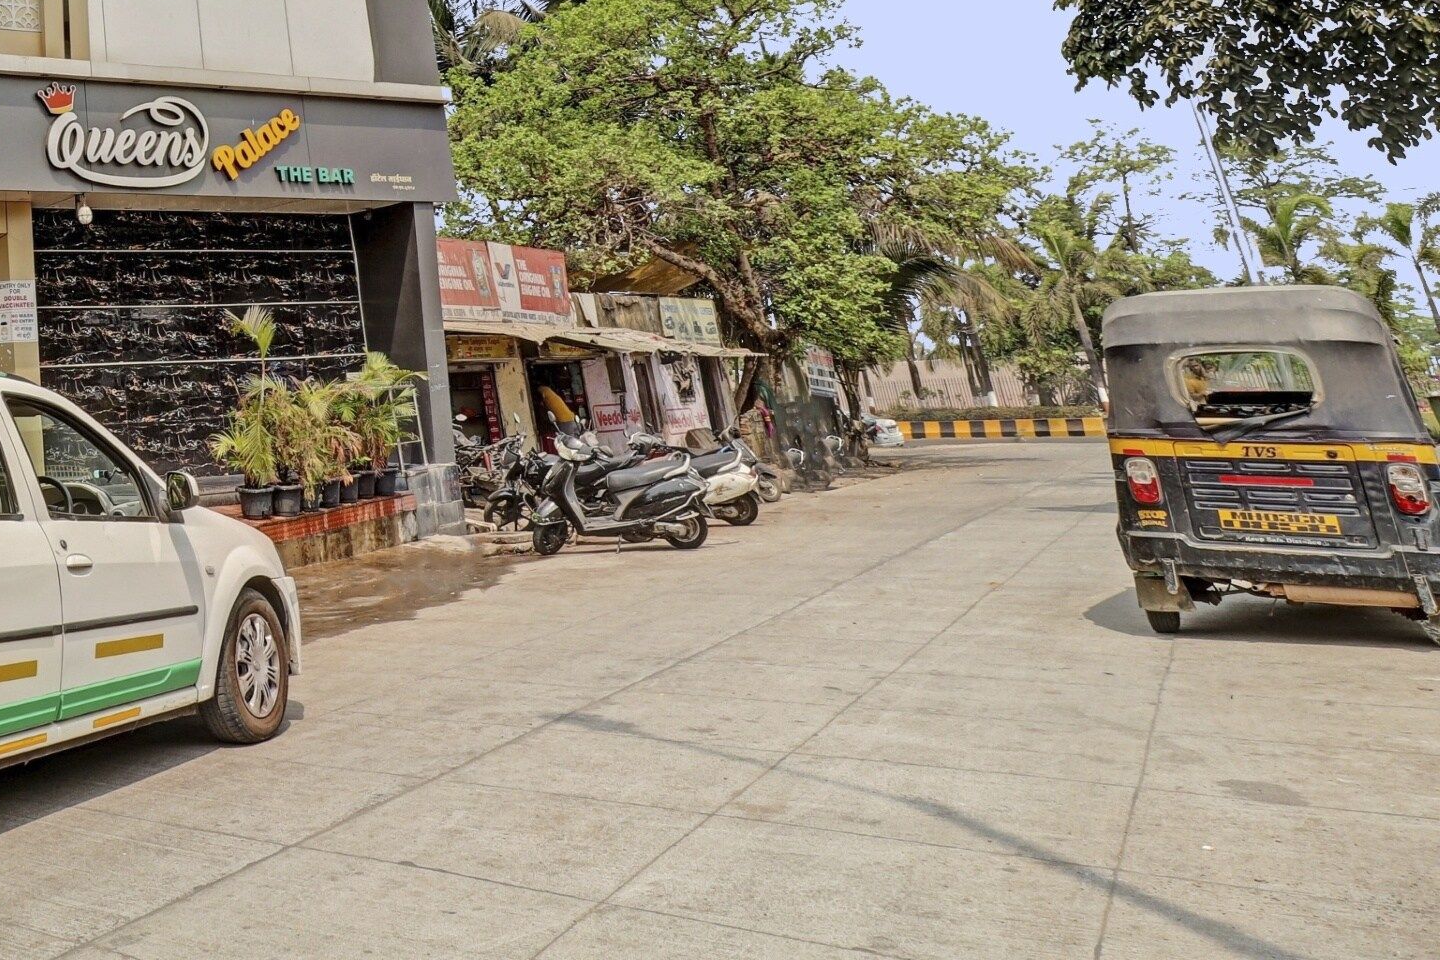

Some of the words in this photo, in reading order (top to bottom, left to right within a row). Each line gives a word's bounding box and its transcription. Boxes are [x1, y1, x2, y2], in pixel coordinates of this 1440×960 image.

[47, 100, 208, 185] Queens
[212, 108, 300, 181] Palace
[276, 165, 313, 183] THE
[318, 167, 356, 185] BAR
[1241, 446, 1278, 458] TVS
[1137, 510, 1167, 520] STOP
[1245, 535, 1265, 543] Keep
